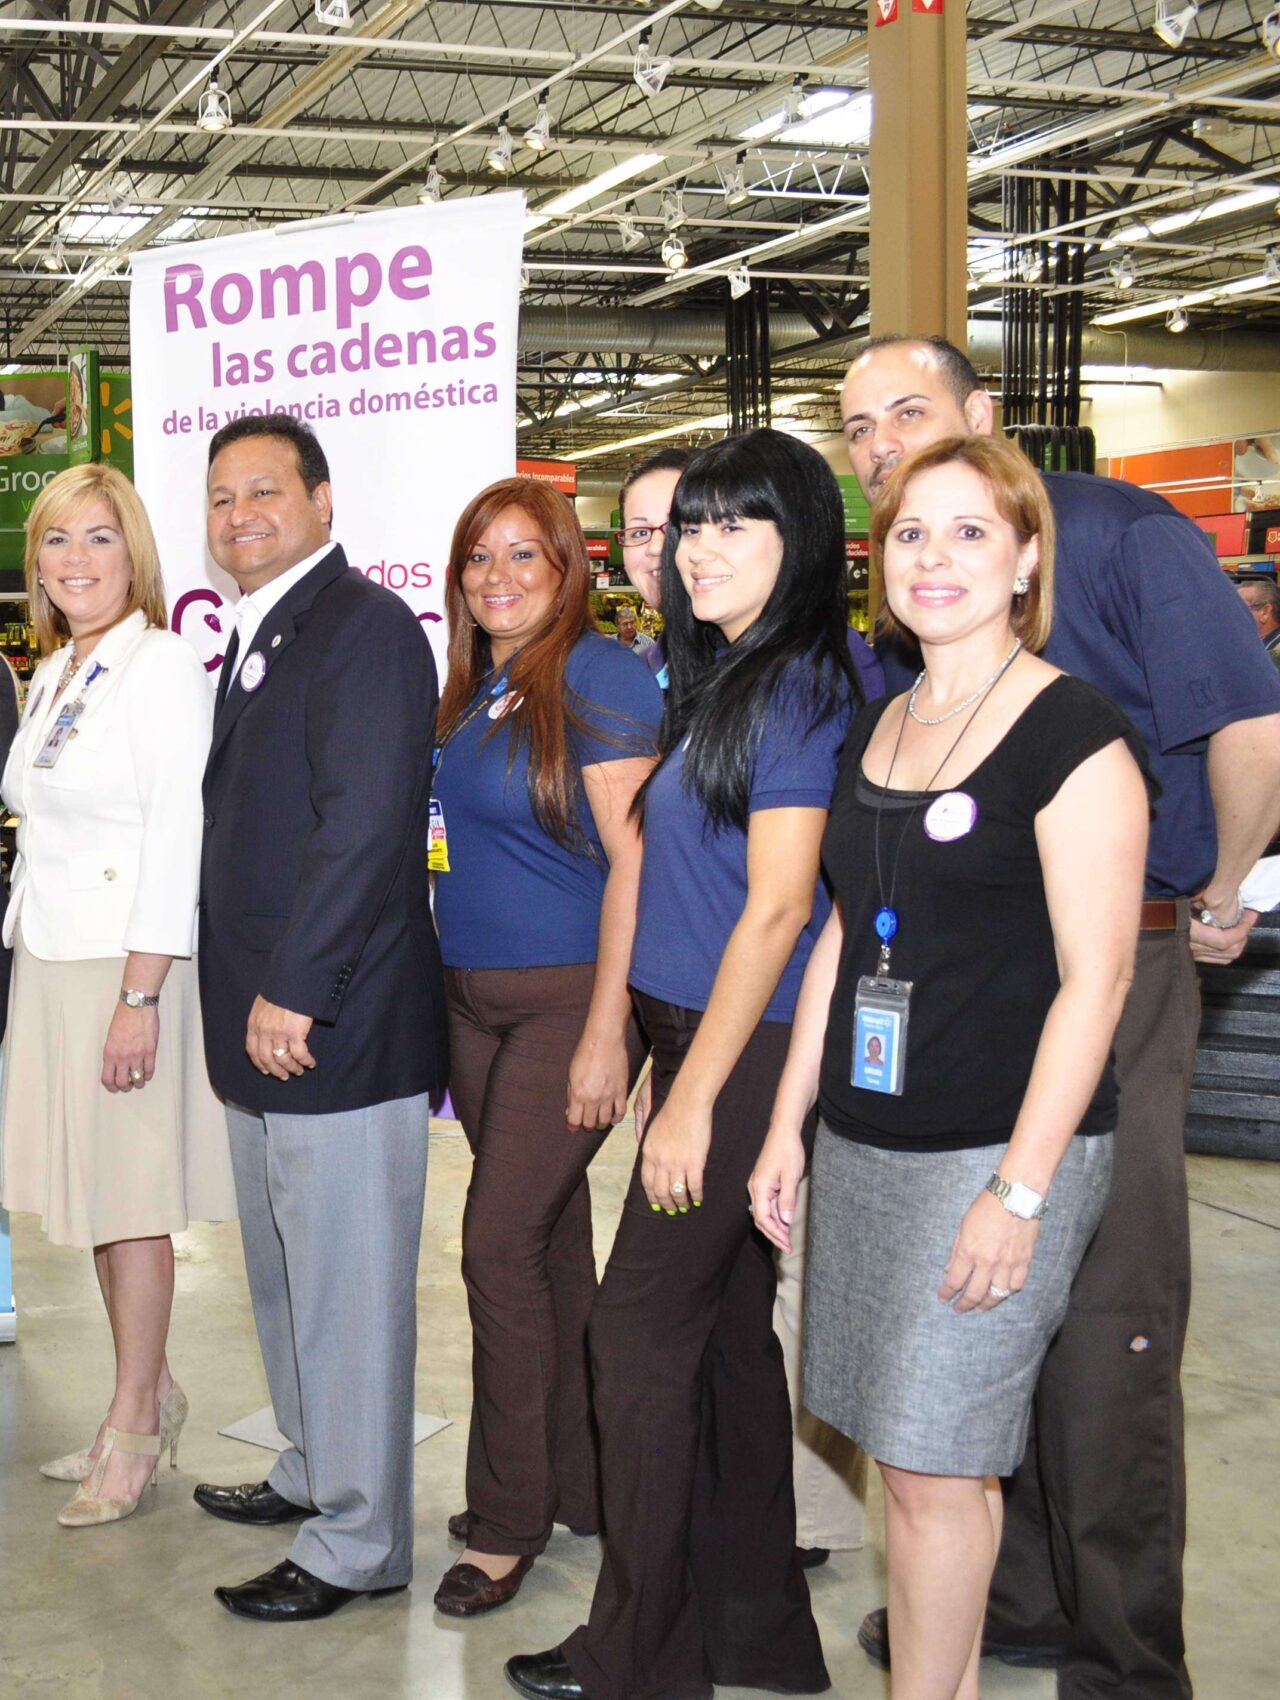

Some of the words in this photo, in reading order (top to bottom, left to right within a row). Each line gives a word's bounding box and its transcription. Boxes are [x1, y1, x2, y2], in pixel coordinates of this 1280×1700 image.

[163, 245, 433, 333] Rompe
[212, 342, 274, 388] las
[287, 322, 497, 379] cadenas
[162, 410, 192, 435] de
[198, 407, 218, 431] la
[348, 379, 498, 416] doméstica
